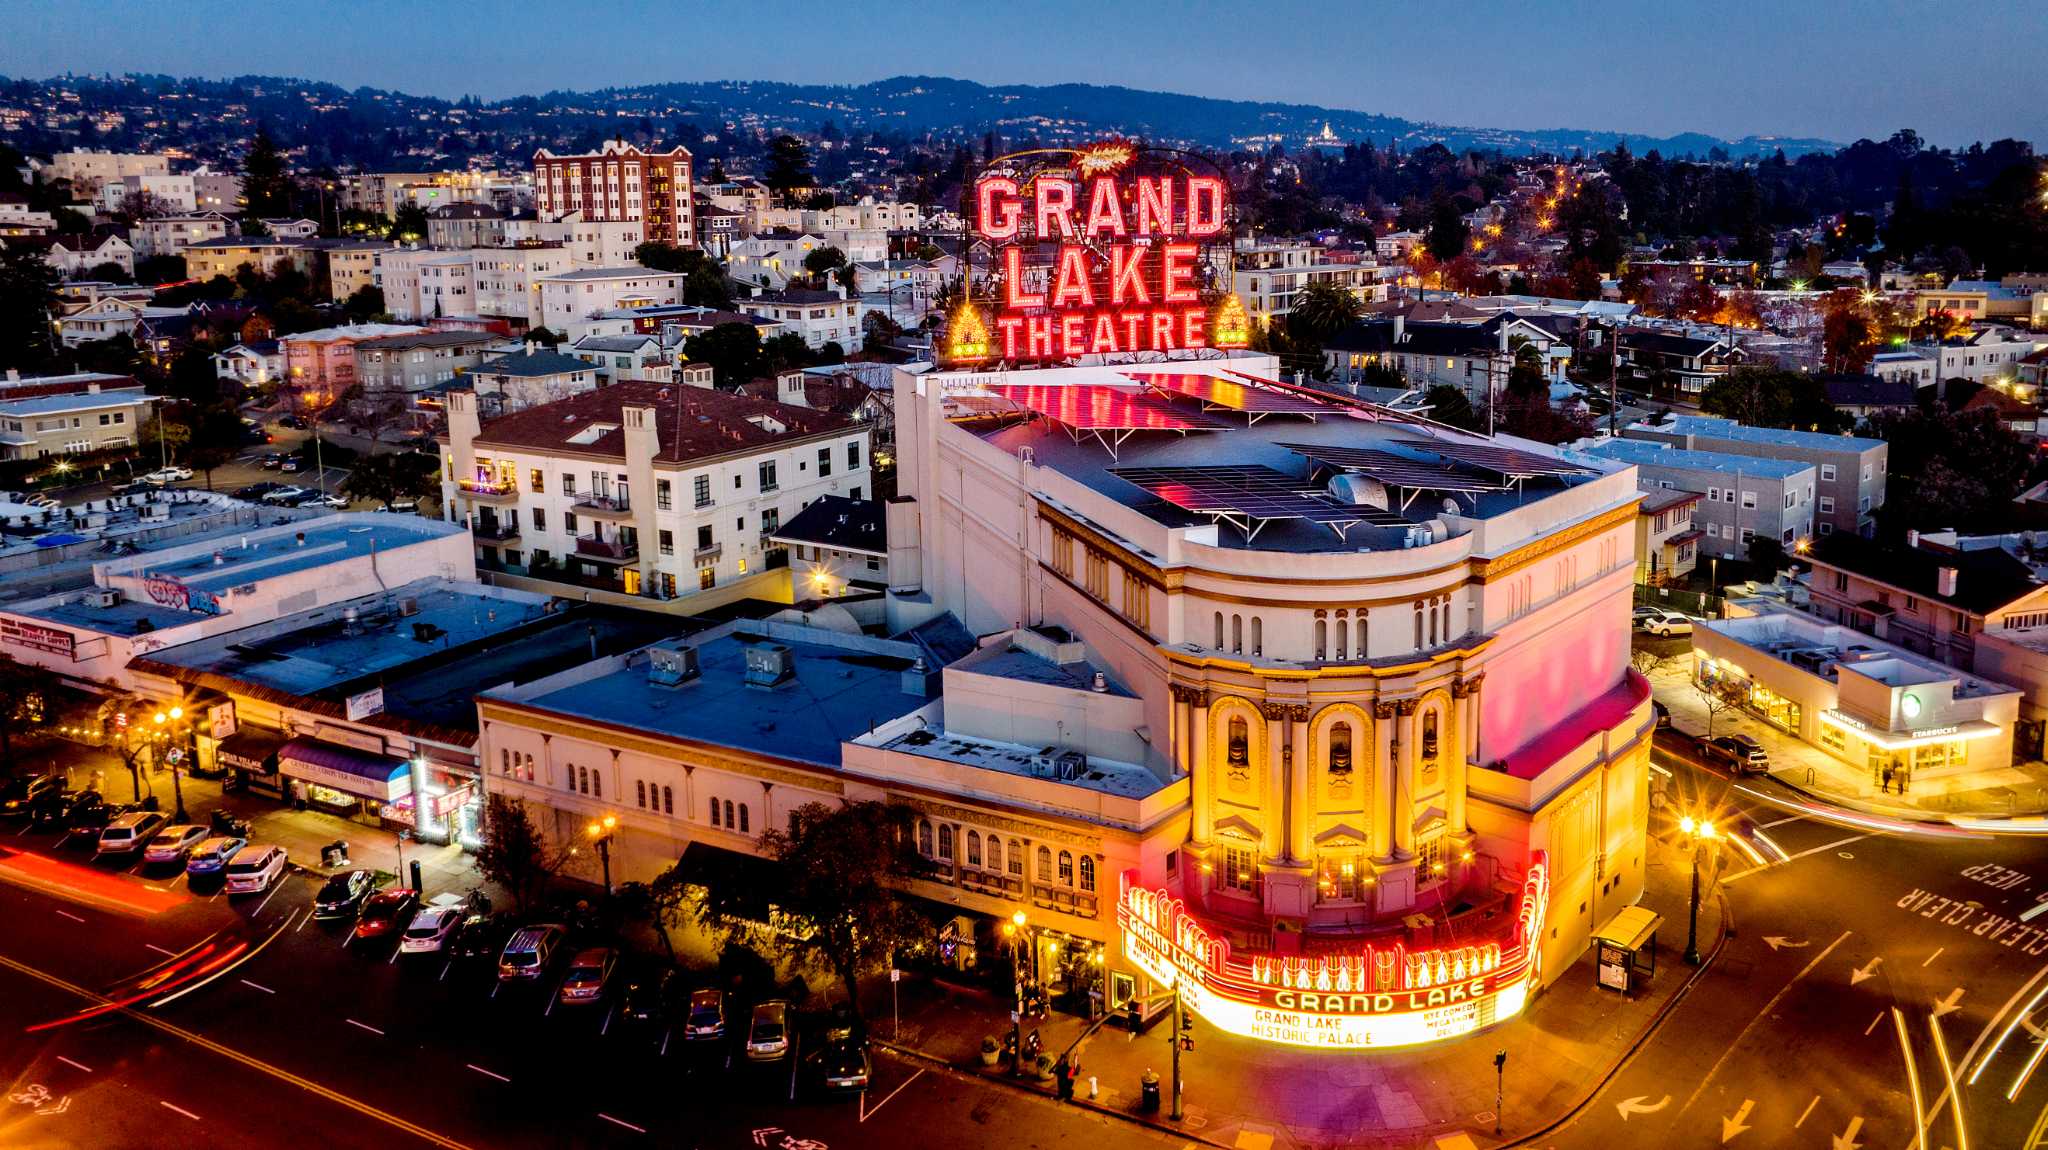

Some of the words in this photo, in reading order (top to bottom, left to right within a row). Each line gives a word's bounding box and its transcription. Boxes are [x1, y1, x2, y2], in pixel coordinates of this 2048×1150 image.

[978, 177, 1224, 239] GRAND
[1006, 245, 1198, 308] LAKE
[998, 310, 1206, 358] THEATRE
[1912, 727, 1957, 738] STARBUCKS
[1960, 863, 2031, 890] KEEP
[1897, 888, 1975, 925] CLEAR
[1129, 916, 1169, 955] GRAND
[1173, 946, 1206, 985] LAKE
[1973, 914, 2048, 956] CLEAR
[1275, 991, 1394, 1012] GRAND
[1410, 978, 1484, 1009] LAKE
[1444, 1002, 1476, 1016] COMEDY
[1252, 1024, 1311, 1043] HISTORIC
[1319, 1032, 1373, 1044] PALACE
[1255, 1010, 1300, 1027] GRAND
[1307, 1016, 1342, 1030] LAKE
